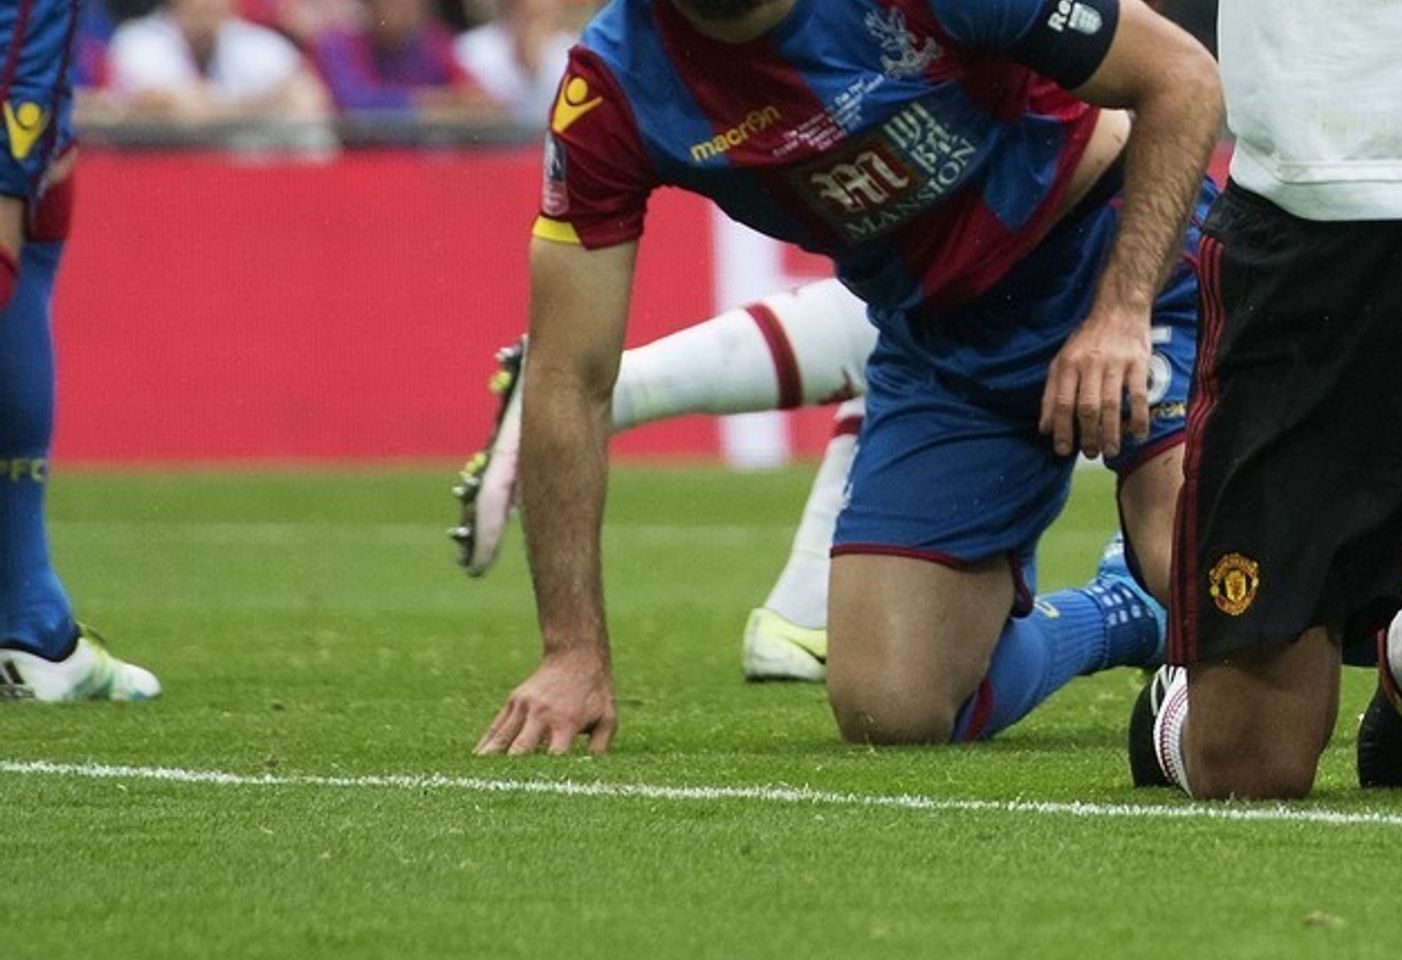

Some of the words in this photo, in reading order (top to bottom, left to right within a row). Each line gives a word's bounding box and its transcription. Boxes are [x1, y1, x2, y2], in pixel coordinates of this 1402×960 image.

[690, 104, 782, 162] macron
[844, 137, 977, 235] MANSION
[0, 457, 48, 482] FC
